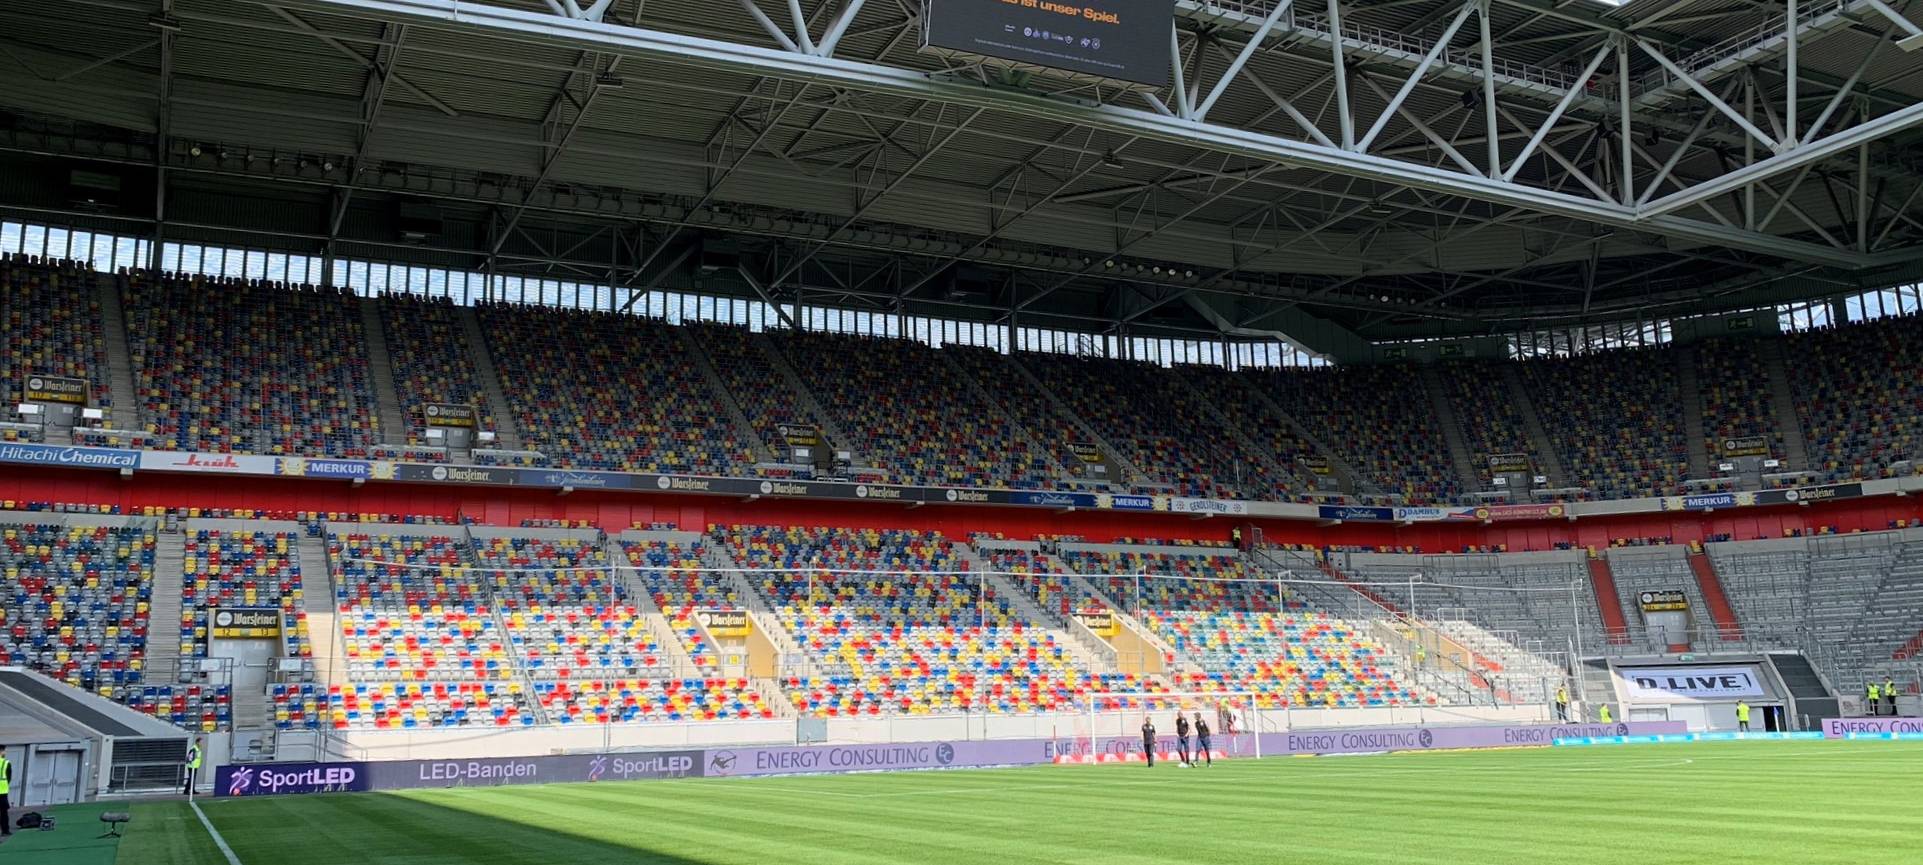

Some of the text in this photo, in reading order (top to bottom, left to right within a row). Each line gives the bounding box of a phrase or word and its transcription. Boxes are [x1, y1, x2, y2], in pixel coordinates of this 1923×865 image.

[1040, 2, 1081, 16] unser
[1083, 7, 1120, 24] Spiel.
[0, 446, 137, 466] Hitachi Chemical
[312, 462, 365, 474] MERKUR
[448, 468, 490, 482] Warsteiner
[1115, 498, 1150, 507] MERKUR
[1688, 496, 1731, 507] MERKUR
[1636, 676, 1742, 690] D.LIVE
[1288, 735, 1336, 751] ENERGY
[1341, 732, 1415, 749] CONSULTING
[1504, 727, 1546, 743] ENERGY
[613, 756, 693, 778] SportLED
[756, 750, 823, 769] ENERGY
[829, 747, 929, 766] CONSULTING
[259, 767, 355, 792] SportLED
[420, 760, 537, 780] LED-Banden
